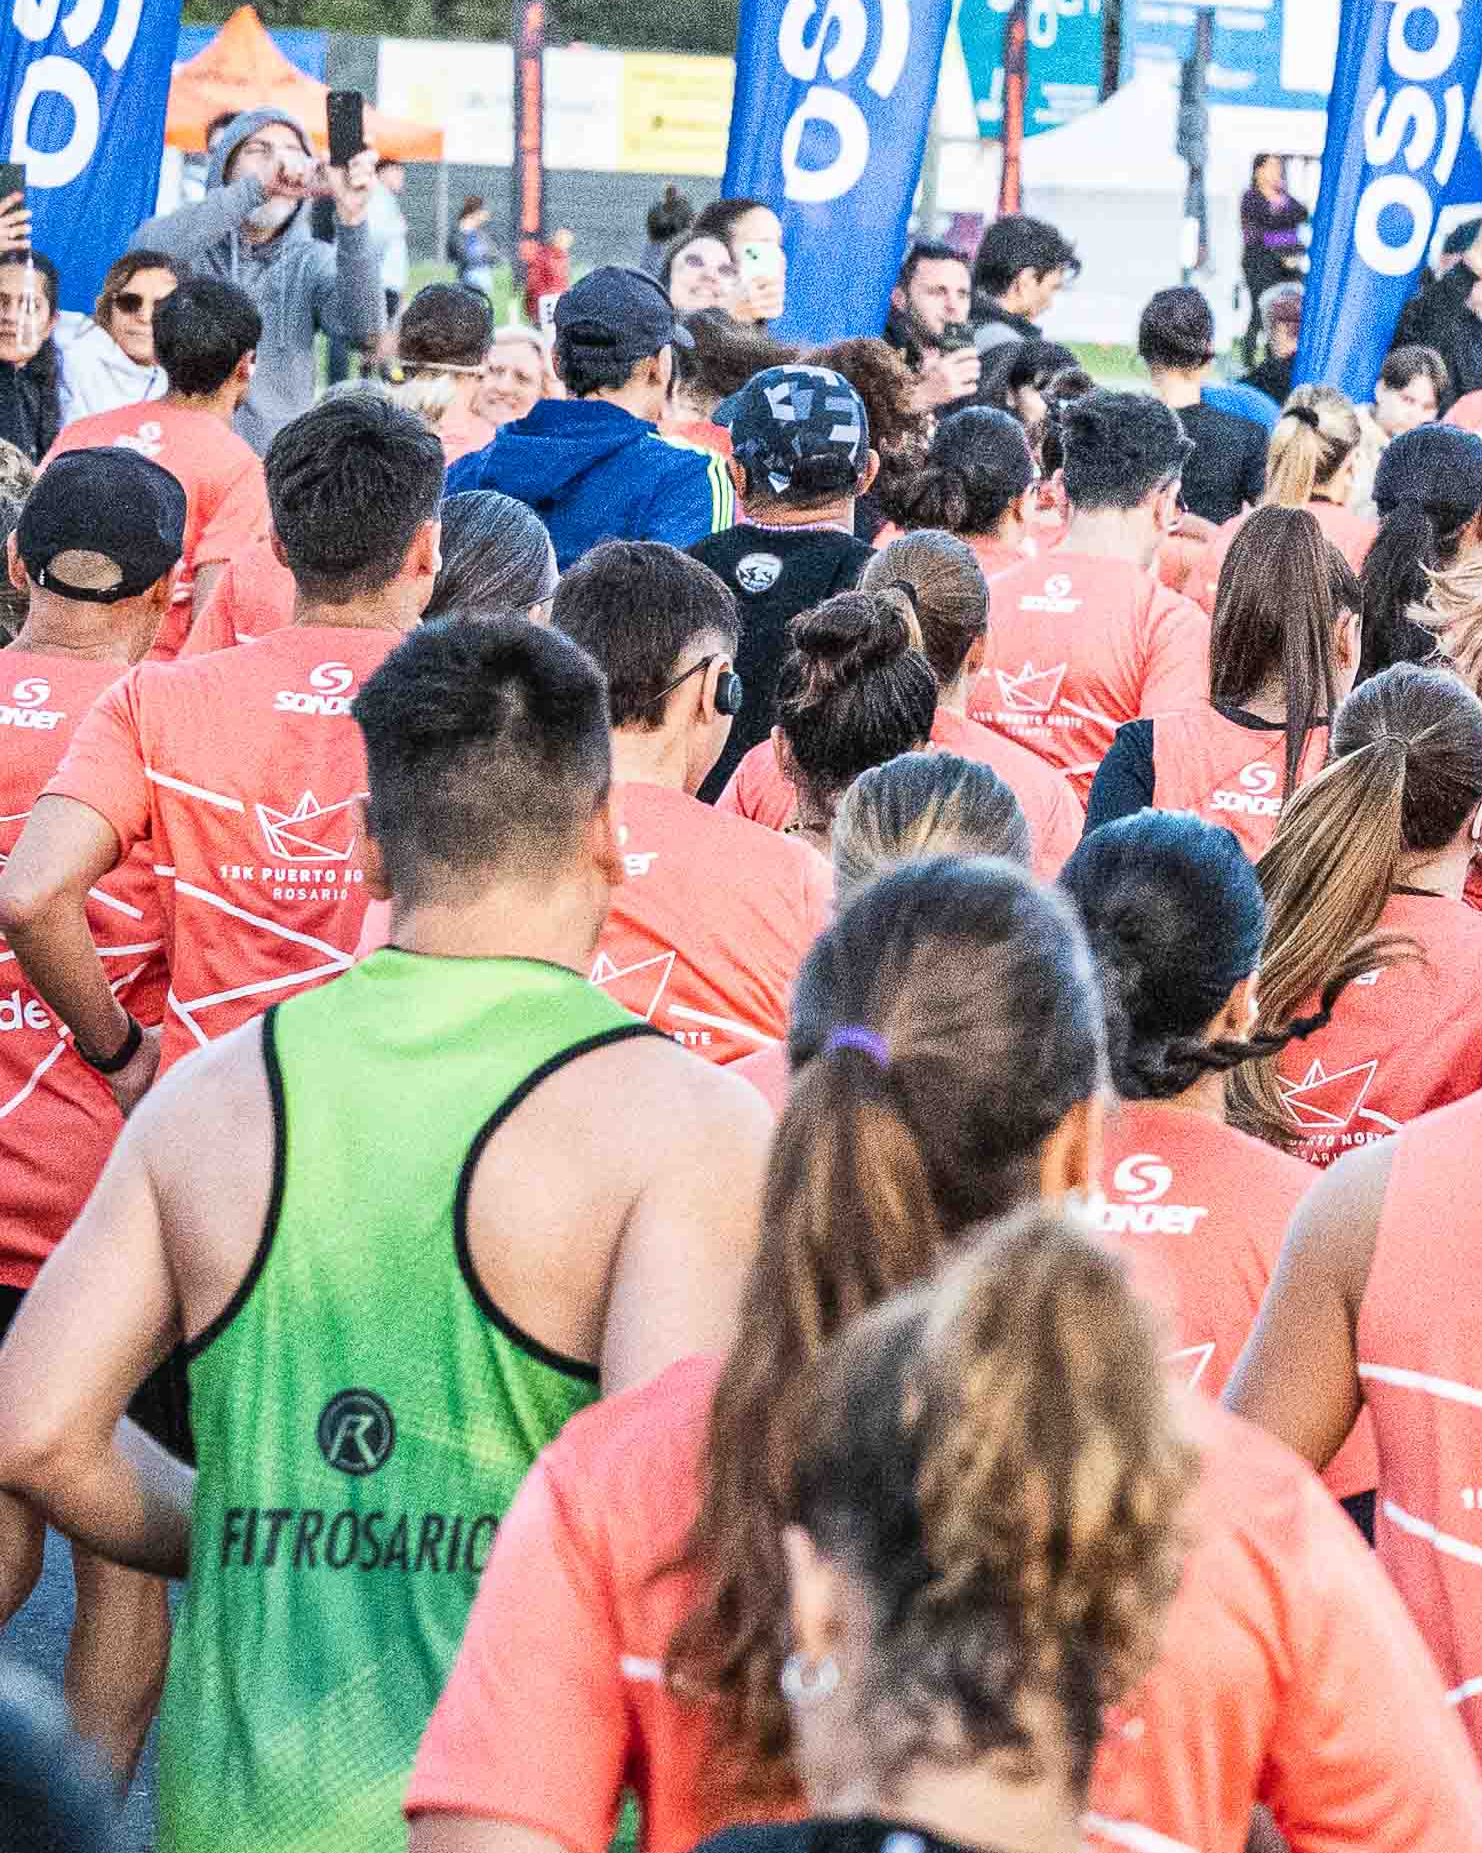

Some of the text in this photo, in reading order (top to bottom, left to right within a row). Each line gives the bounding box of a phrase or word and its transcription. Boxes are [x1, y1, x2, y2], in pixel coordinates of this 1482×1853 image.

[1210, 790, 1282, 816] SONDE
[262, 866, 337, 884] PUERTO
[272, 887, 349, 901] ROSARIO
[219, 1507, 500, 1573] FITROSARIO
